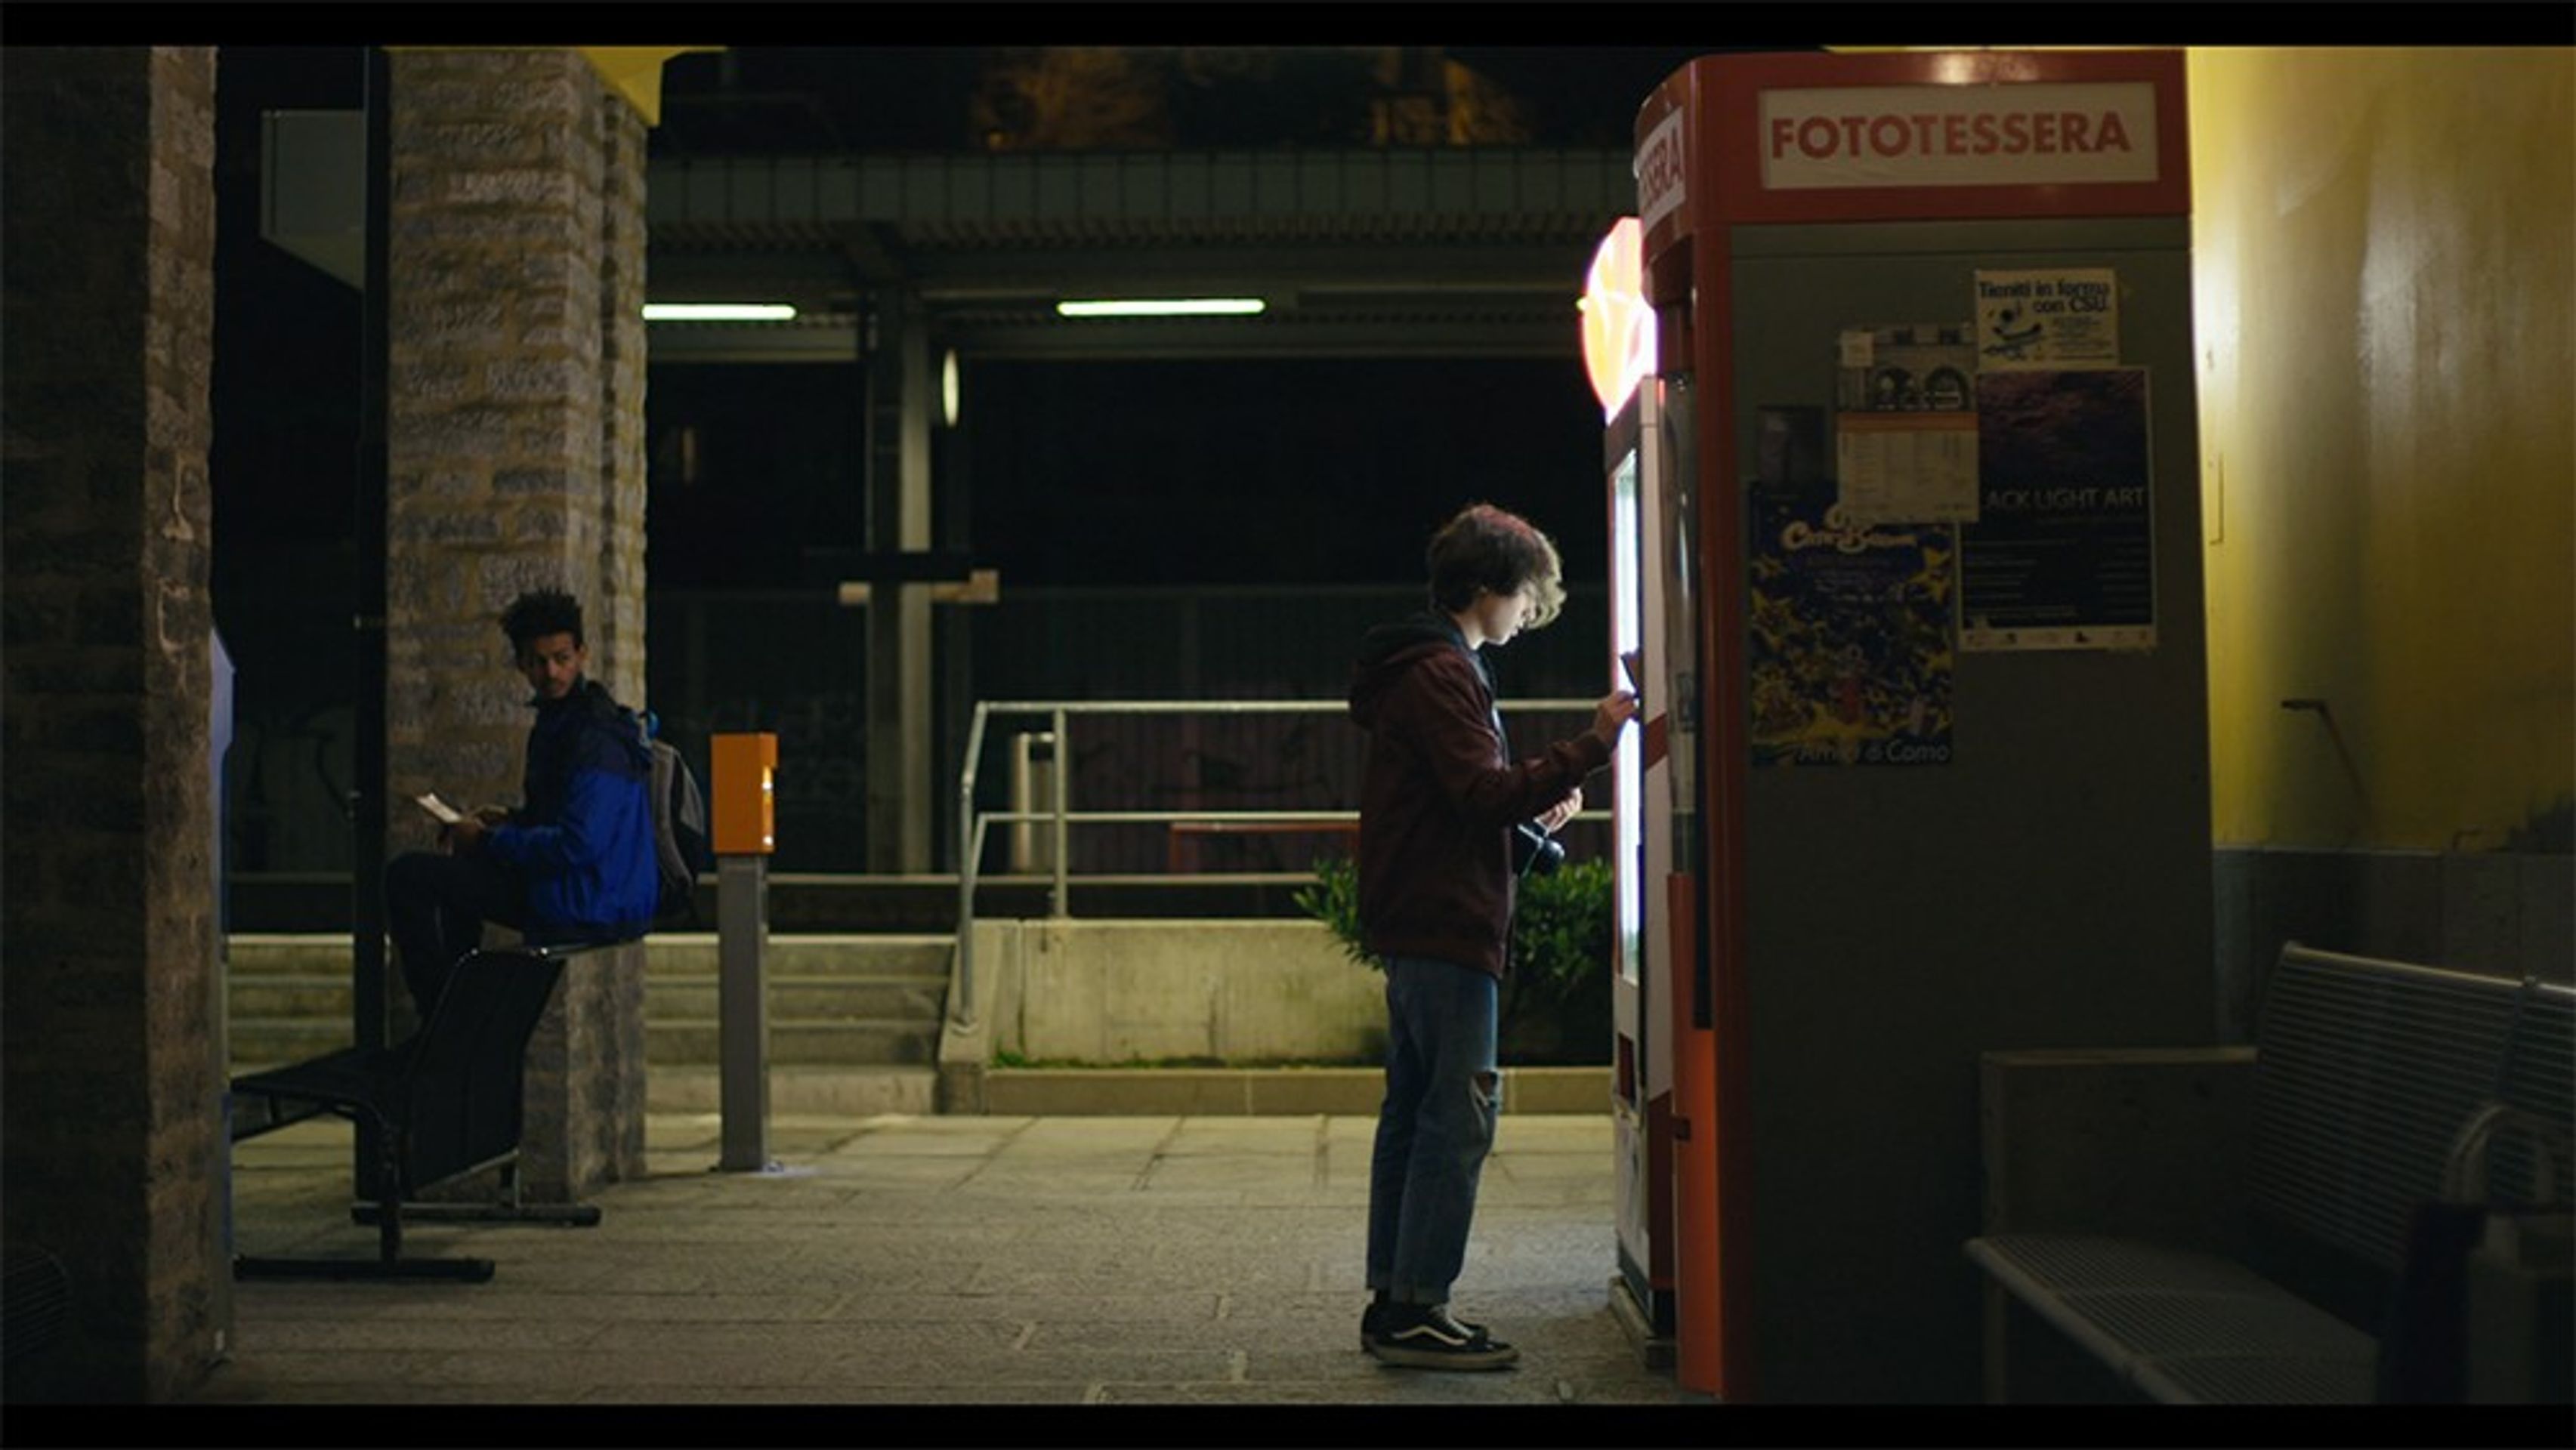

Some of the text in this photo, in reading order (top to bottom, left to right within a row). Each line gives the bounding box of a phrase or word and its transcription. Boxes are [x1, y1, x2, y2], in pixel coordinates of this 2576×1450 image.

[1771, 110, 2131, 159] FOTOTESSERA
[2036, 280, 2053, 296] in
[2058, 278, 2110, 298] forma
[2034, 301, 2065, 313] con
[2034, 488, 2100, 509] LIGHT
[2103, 486, 2145, 508] ART
[1886, 739, 1951, 763] Como
